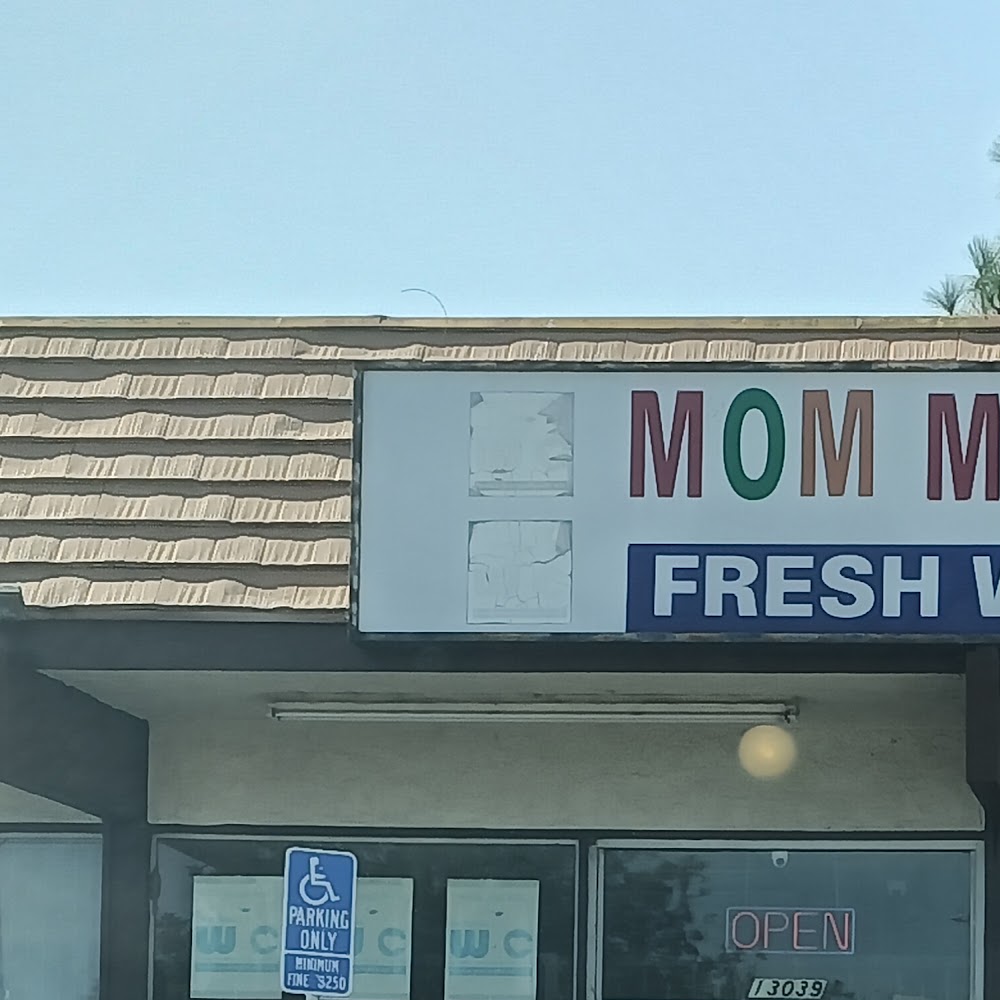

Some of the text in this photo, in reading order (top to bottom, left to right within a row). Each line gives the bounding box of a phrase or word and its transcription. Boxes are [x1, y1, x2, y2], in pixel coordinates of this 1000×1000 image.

[630, 388, 874, 500] MOM
[653, 554, 941, 618] FRESH
[288, 905, 350, 930] PARKING
[300, 929, 338, 951] ONLY
[732, 911, 849, 951] OPEN
[287, 973, 310, 988] FINE
[754, 980, 823, 998] 13039
